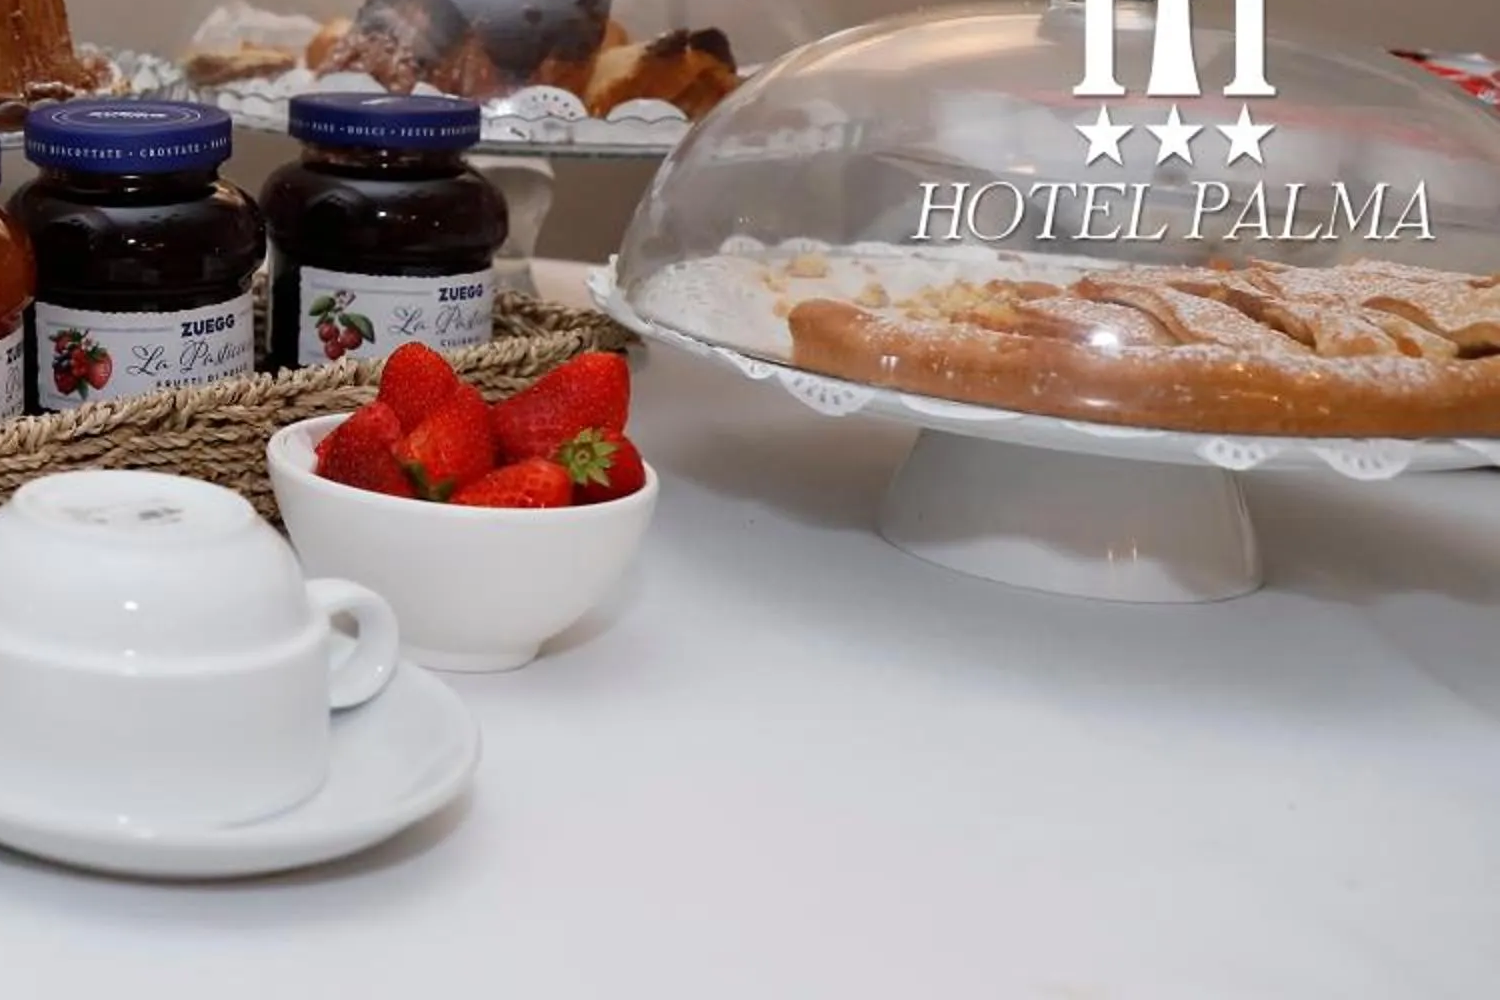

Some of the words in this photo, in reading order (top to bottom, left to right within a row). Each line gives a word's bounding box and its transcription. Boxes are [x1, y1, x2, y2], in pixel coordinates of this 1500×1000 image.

[139, 142, 200, 159] CROSTATE
[437, 283, 483, 302] ZUEGG
[180, 313, 236, 338] ZUEGG
[388, 304, 428, 336] La
[124, 343, 170, 377] La
